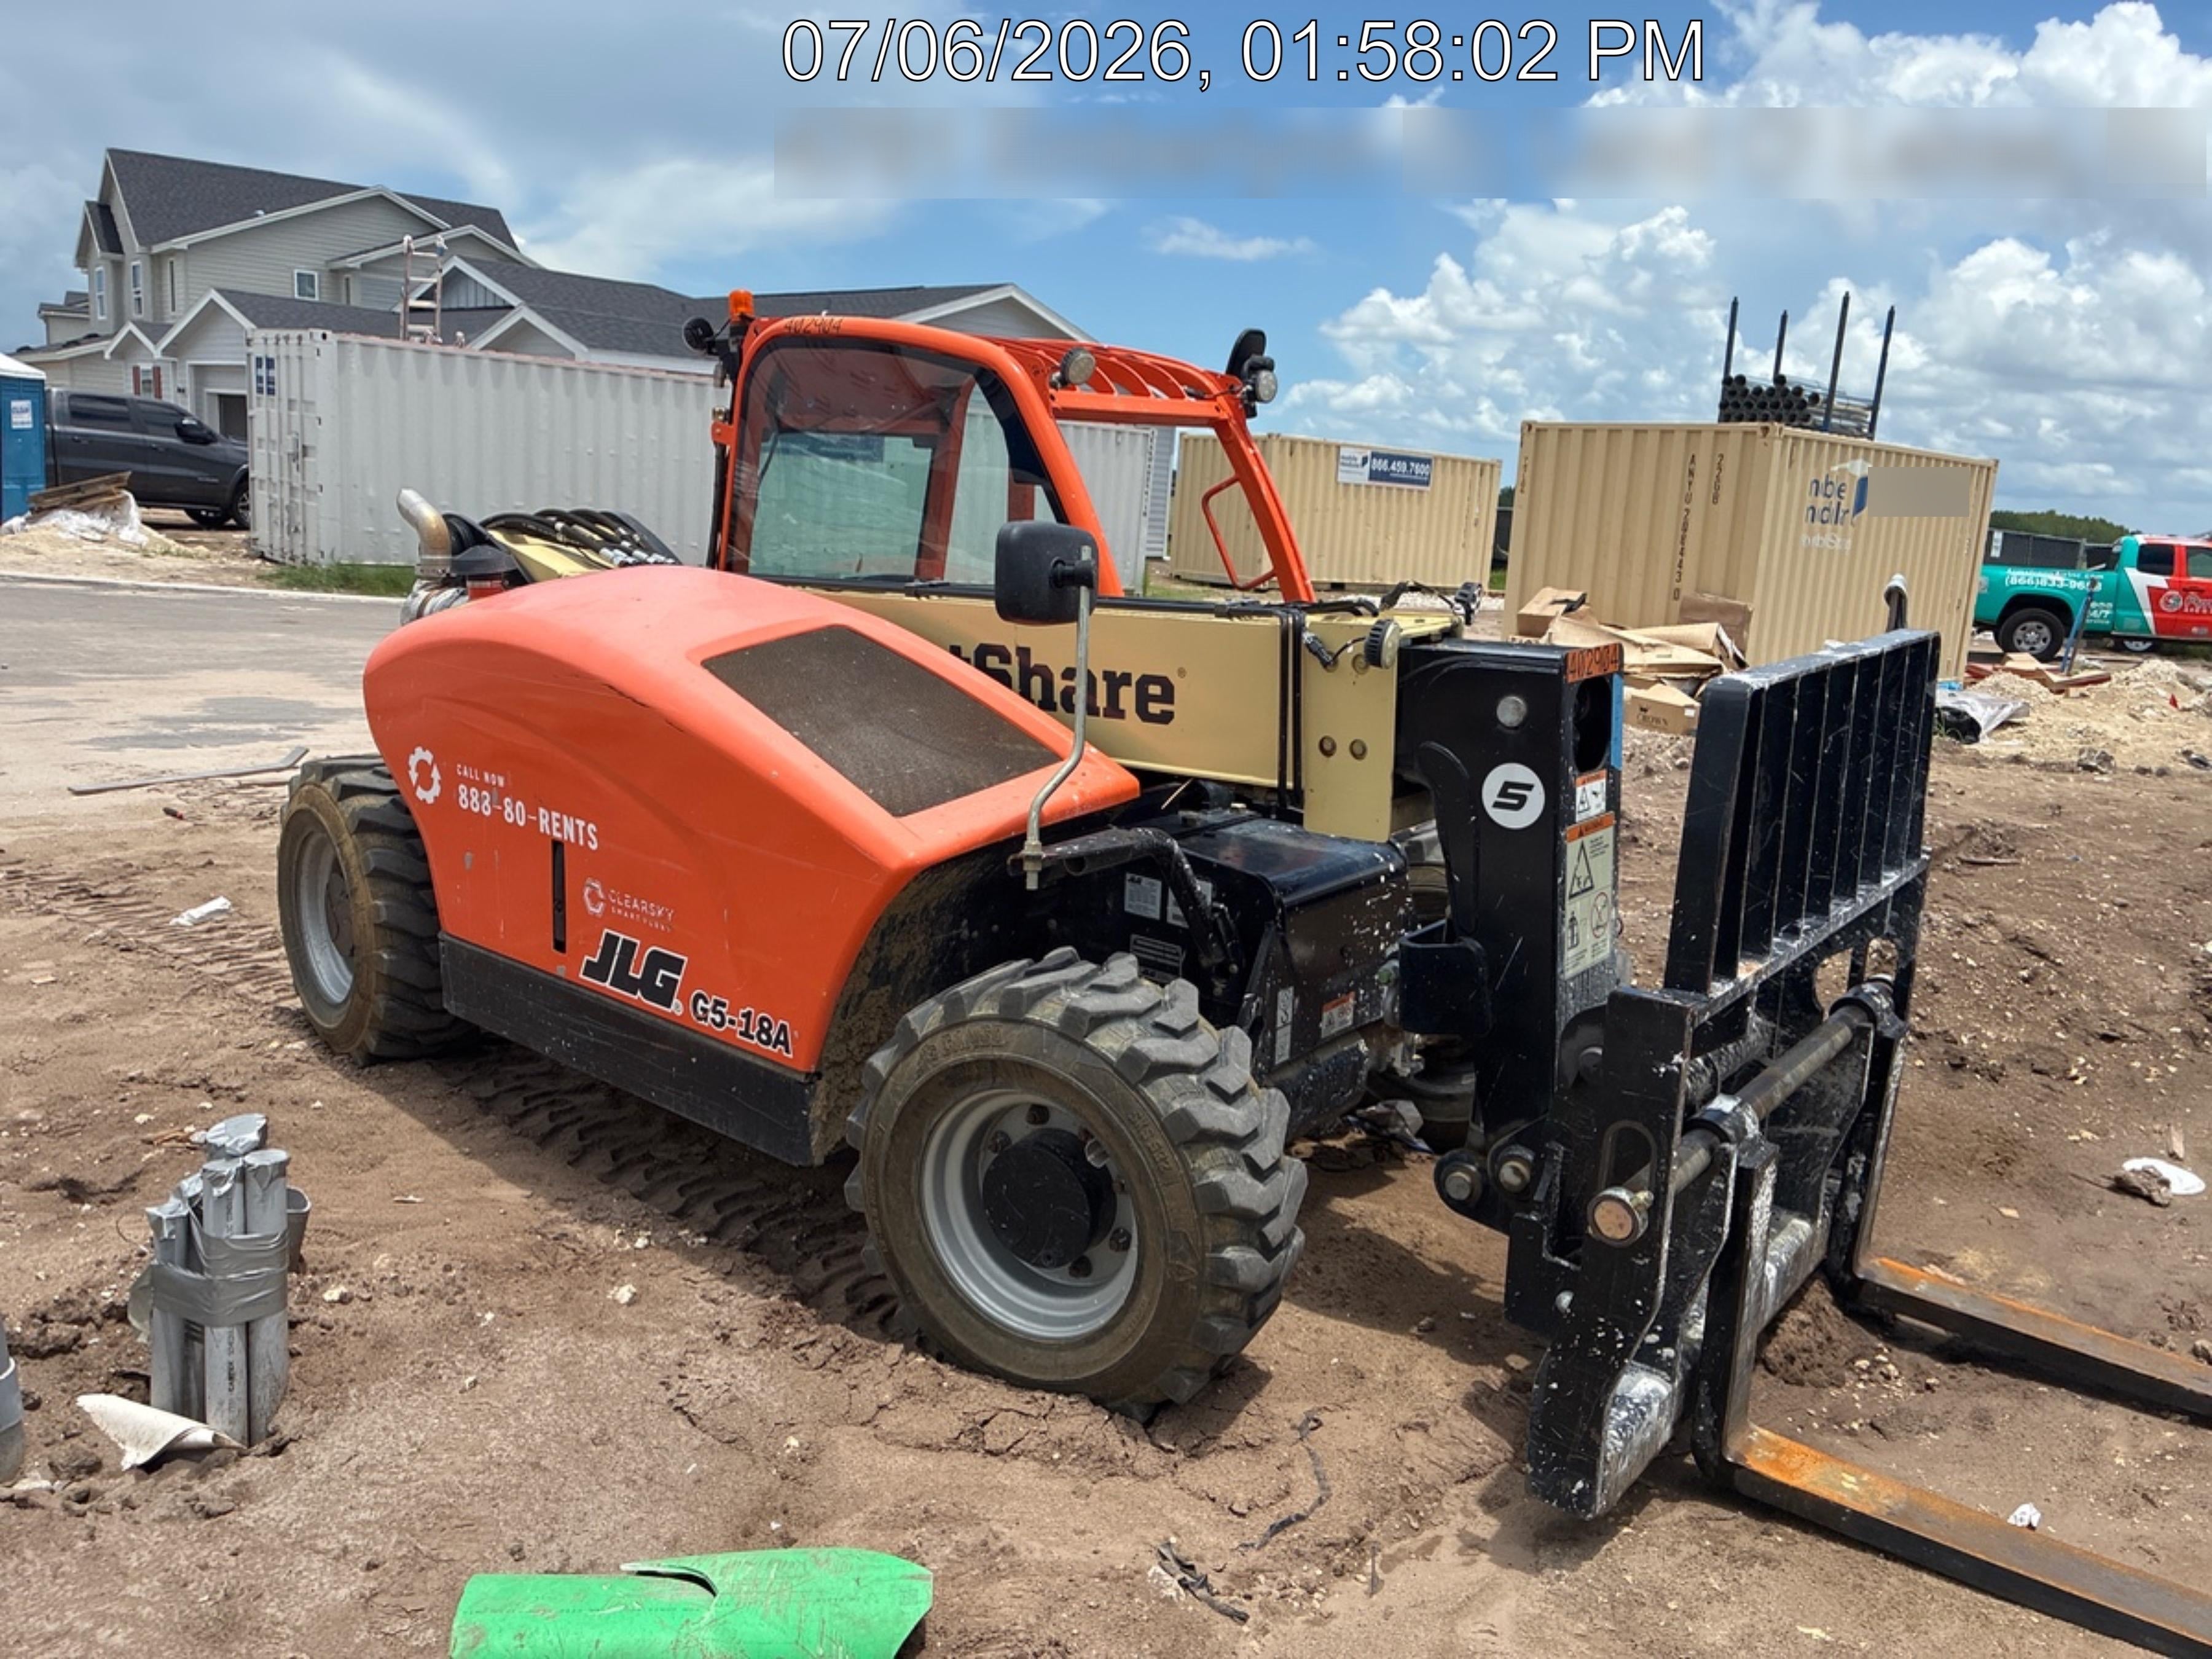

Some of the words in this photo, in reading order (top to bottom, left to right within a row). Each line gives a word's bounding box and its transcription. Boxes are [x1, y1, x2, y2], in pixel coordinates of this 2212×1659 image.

[456, 764, 480, 780] CALL
[482, 771, 506, 788] NOW
[458, 783, 598, 851] 888-80-RENTS
[608, 888, 675, 922] CLEARSKY
[579, 928, 688, 1013] JLG
[689, 989, 793, 1059] G5-18A
